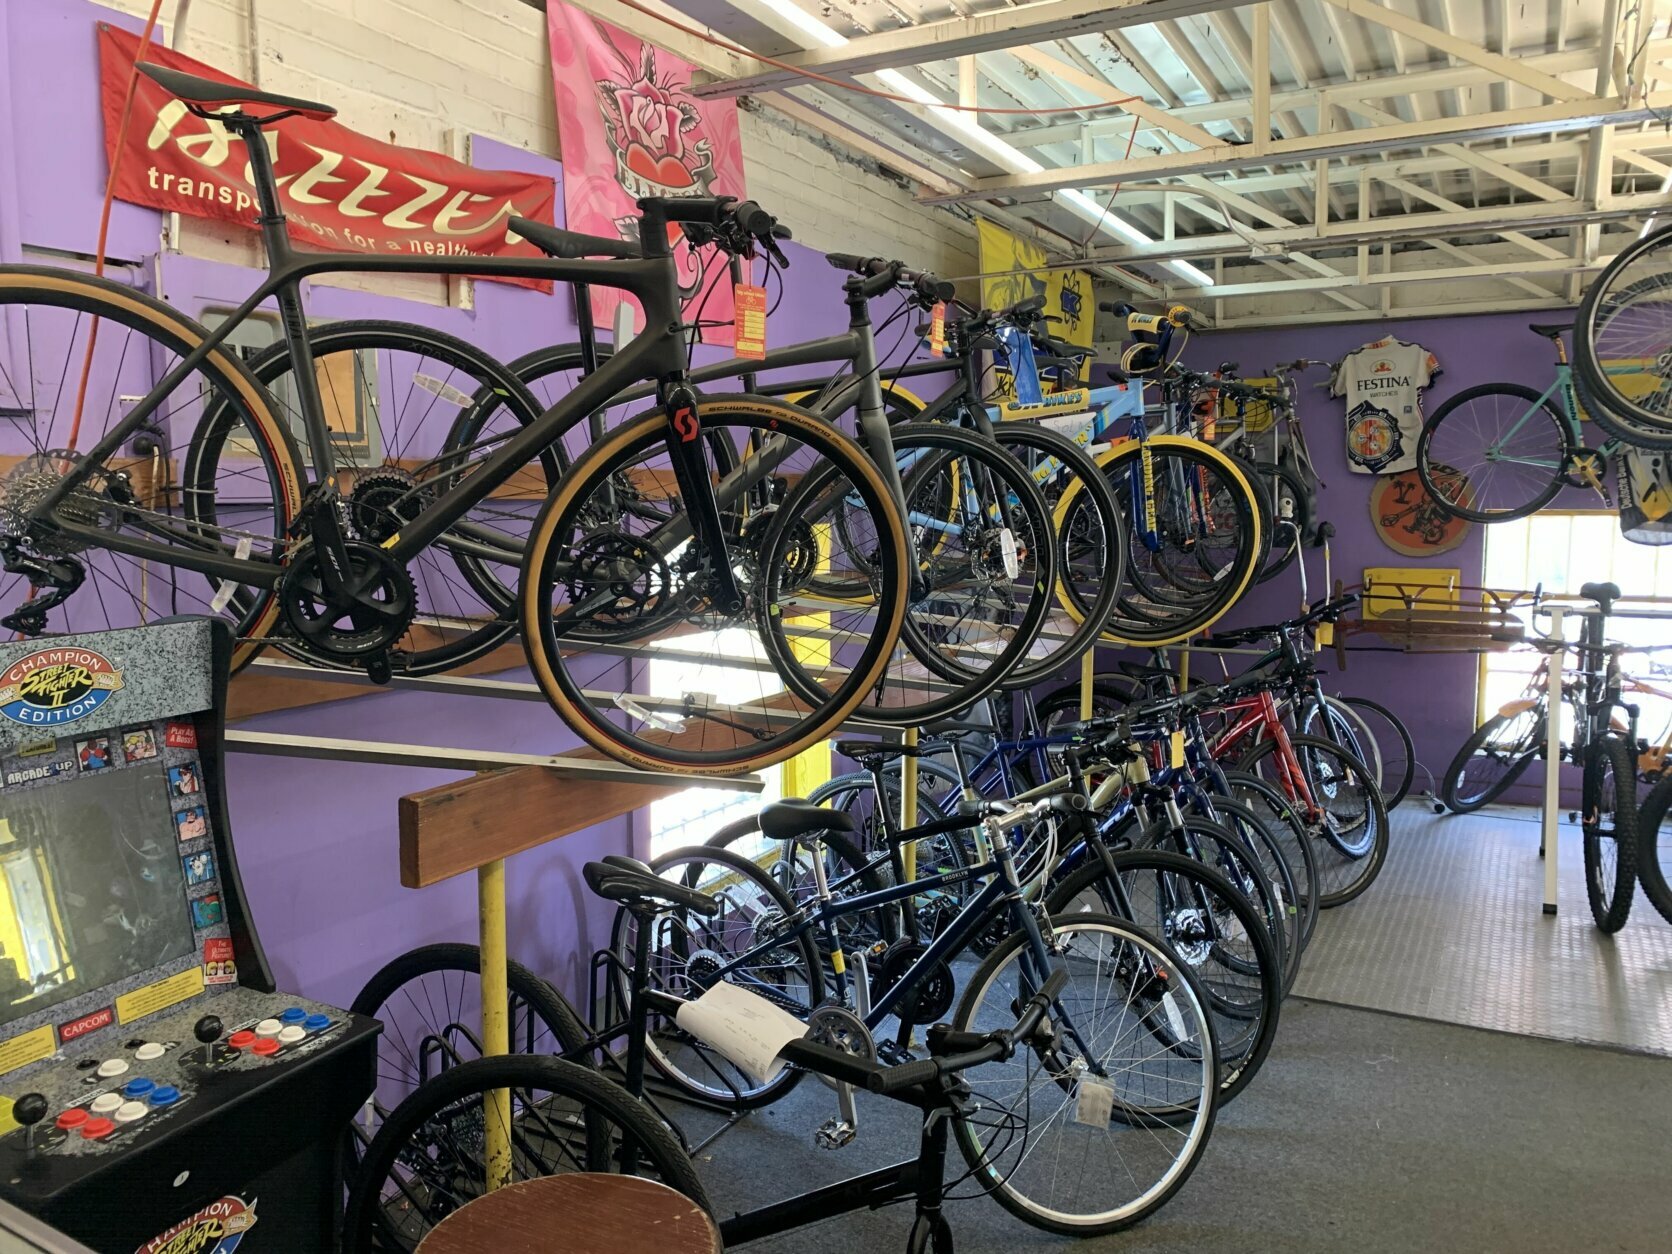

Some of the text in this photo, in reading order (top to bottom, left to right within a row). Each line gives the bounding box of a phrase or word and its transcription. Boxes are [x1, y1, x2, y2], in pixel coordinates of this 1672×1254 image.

[343, 227, 376, 250] for
[386, 239, 402, 251] a
[1356, 376, 1411, 392] FESTINA
[1565, 384, 1577, 420] Bianchi
[708, 406, 832, 438] SCHWALBE DURANO
[282, 462, 298, 519] SCHWAL
[9, 651, 102, 682] CHAMPION
[20, 662, 70, 697] STREET
[28, 666, 93, 697] FIGHTER
[18, 696, 97, 722] EDITION
[48, 688, 71, 708] II
[941, 870, 969, 882] BROOKLYN
[63, 1013, 109, 1038] CAPCOM
[147, 1202, 233, 1253] HAMPION
